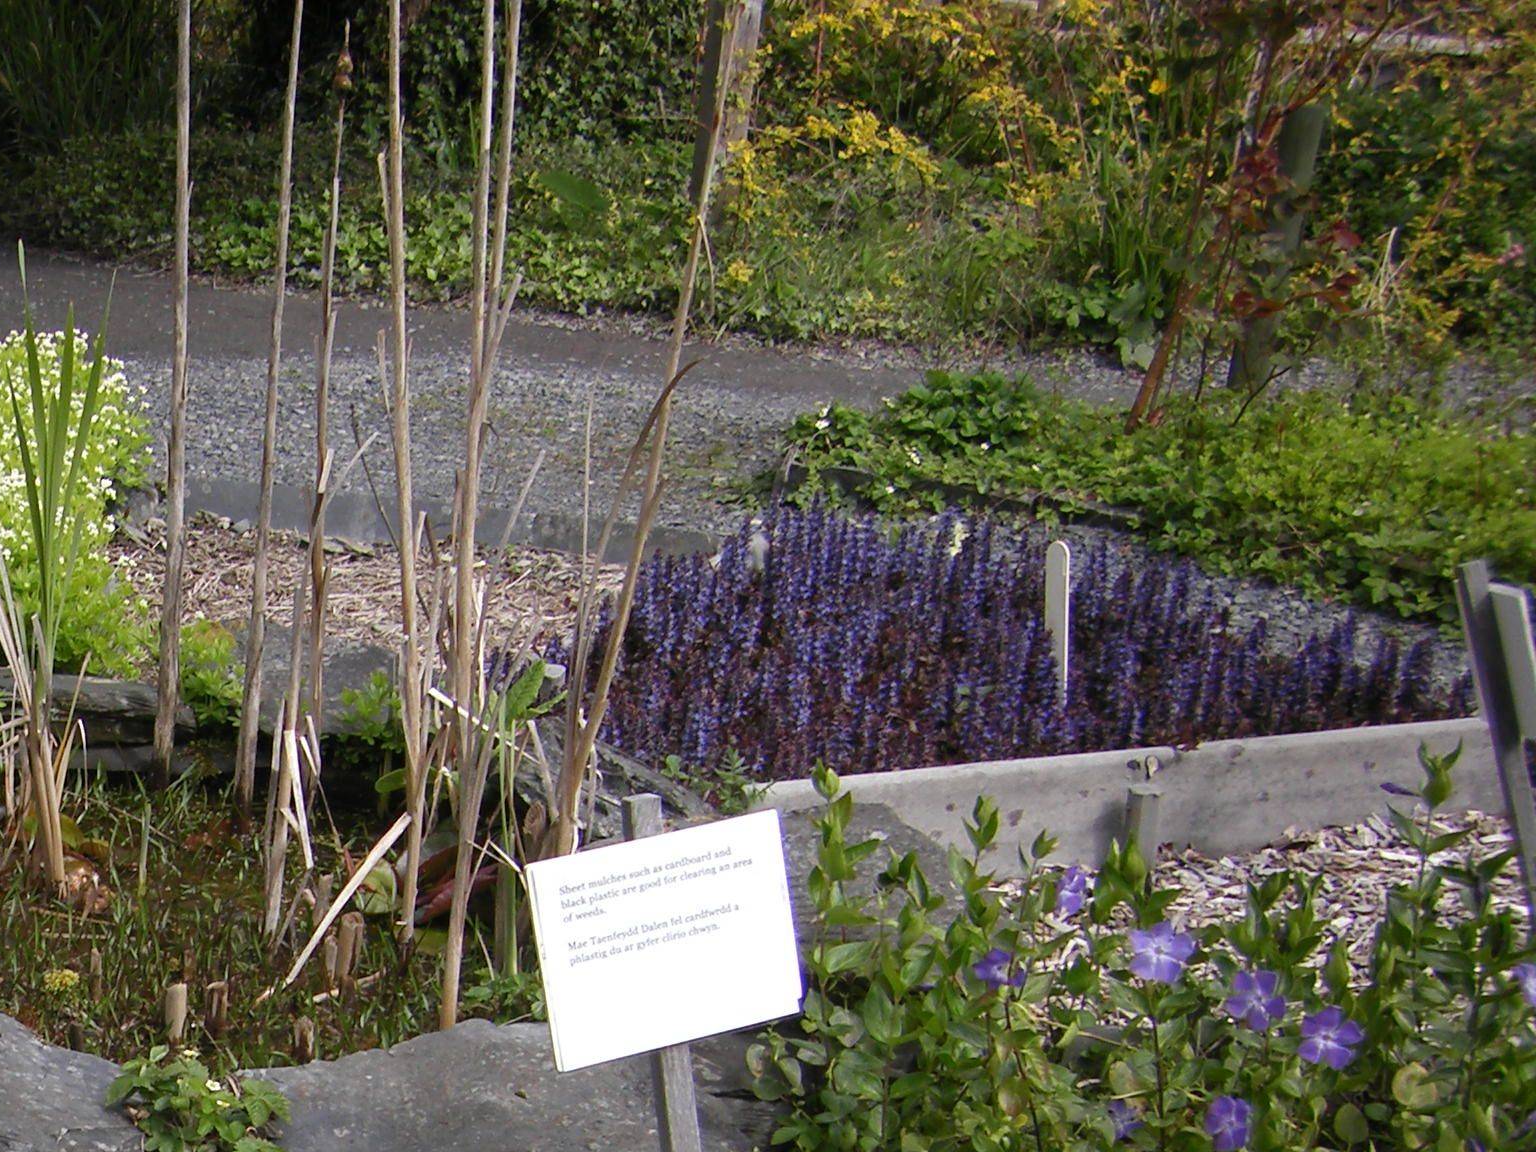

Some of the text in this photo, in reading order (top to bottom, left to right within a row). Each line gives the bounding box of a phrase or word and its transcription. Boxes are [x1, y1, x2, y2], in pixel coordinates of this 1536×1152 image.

[559, 883, 586, 896] Sheet
[588, 873, 627, 887] mulches
[629, 867, 650, 878] such
[665, 853, 712, 870] cardboard
[714, 847, 732, 858] and
[560, 896, 586, 909] black
[589, 890, 620, 905] plastic
[622, 887, 637, 895] are
[639, 879, 661, 892] good
[664, 875, 677, 885] for
[680, 866, 717, 881] clearing
[733, 858, 753, 868] area
[562, 914, 573, 923] of
[568, 939, 588, 951] Mae
[590, 926, 639, 945] Taenfeydd
[641, 920, 668, 934] Dalen
[670, 916, 683, 926] fel
[569, 949, 608, 966] phlastig
[609, 945, 622, 955] du
[624, 943, 634, 952] ar
[636, 936, 660, 950] gyfer
